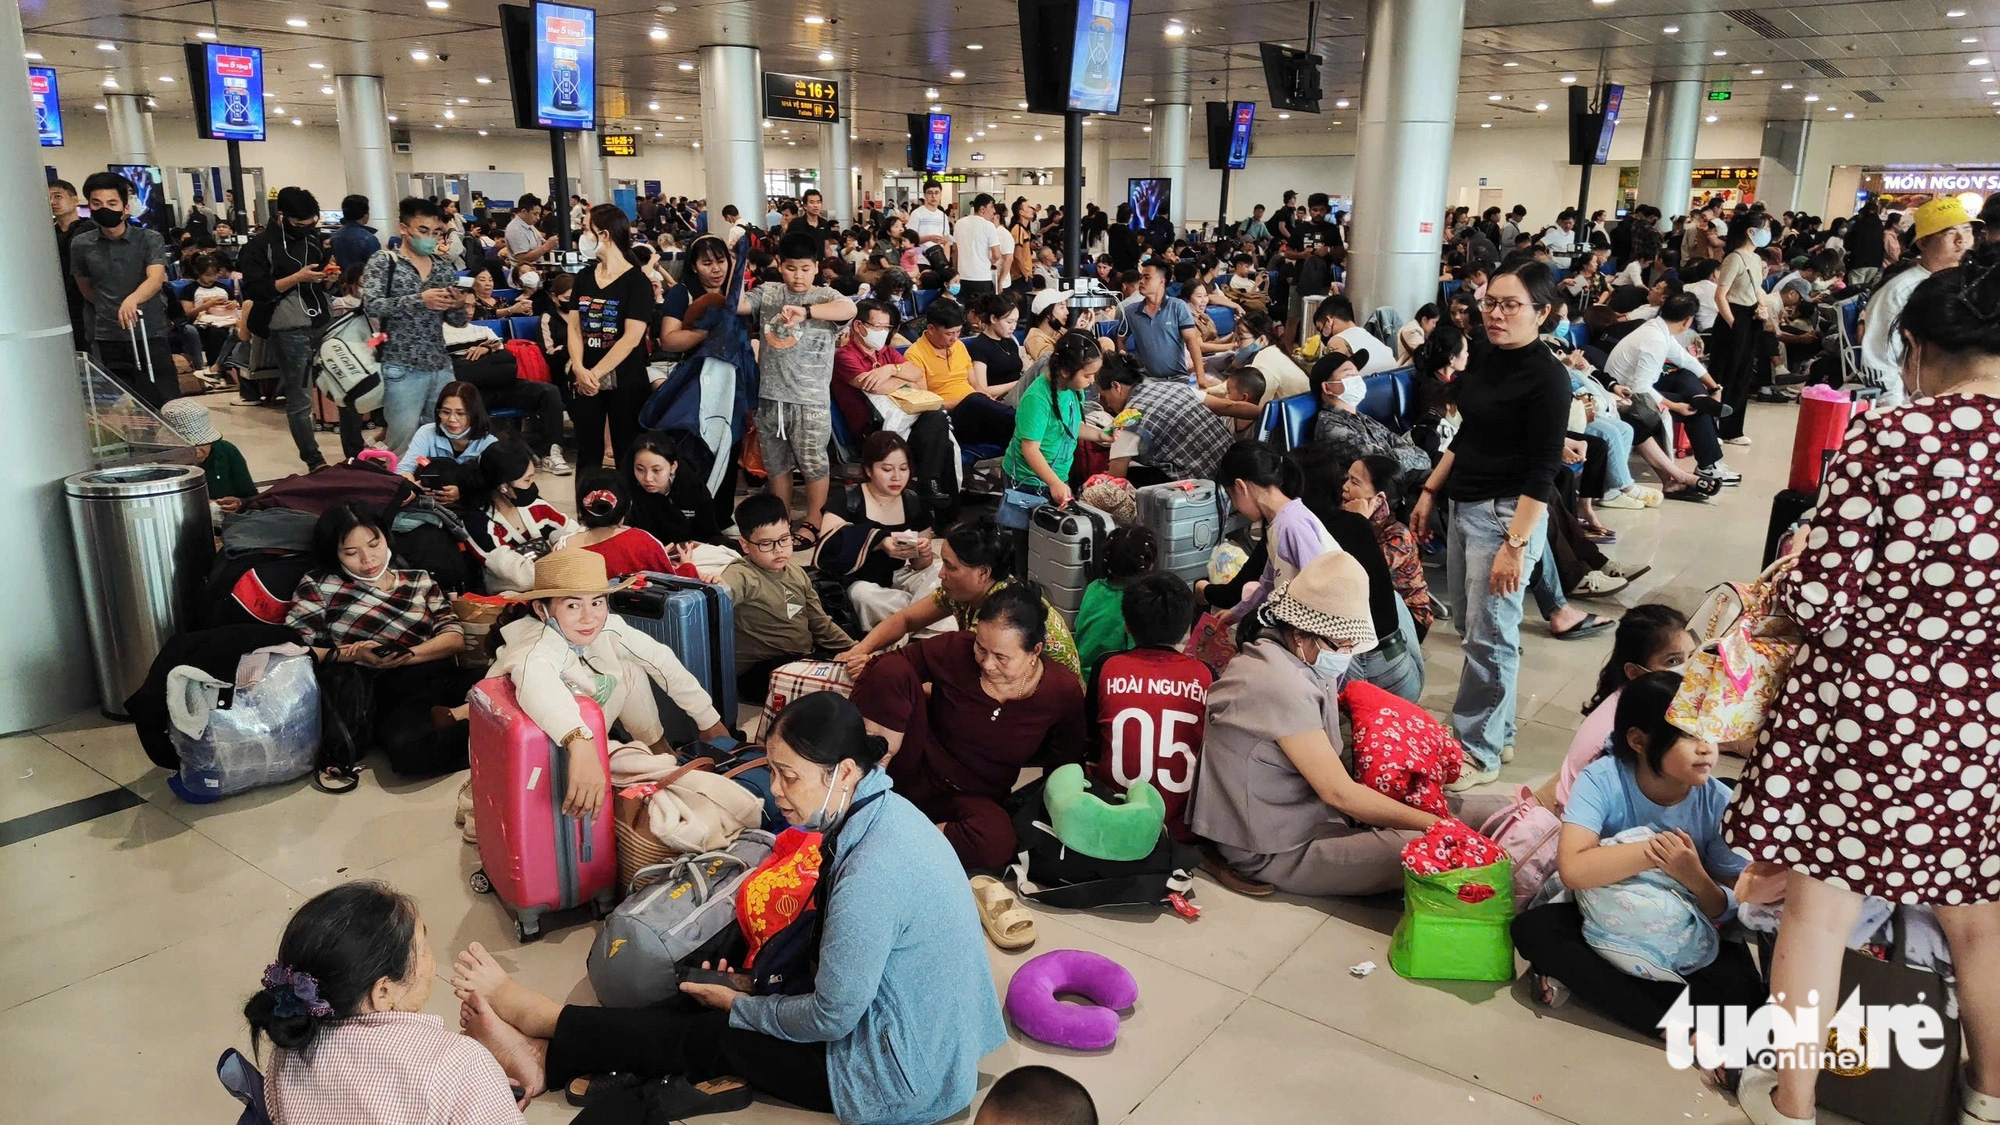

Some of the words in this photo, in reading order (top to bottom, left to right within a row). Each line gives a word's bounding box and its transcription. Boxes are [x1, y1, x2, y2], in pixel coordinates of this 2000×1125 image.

[561, 26, 567, 35] 5
[808, 82, 823, 98] 16
[1735, 170, 1747, 178] 16
[1883, 173, 1927, 190] MÓN
[1107, 674, 1143, 695] HOÀI
[1147, 678, 1208, 706] NGUYỄN
[1111, 707, 1199, 794] 05
